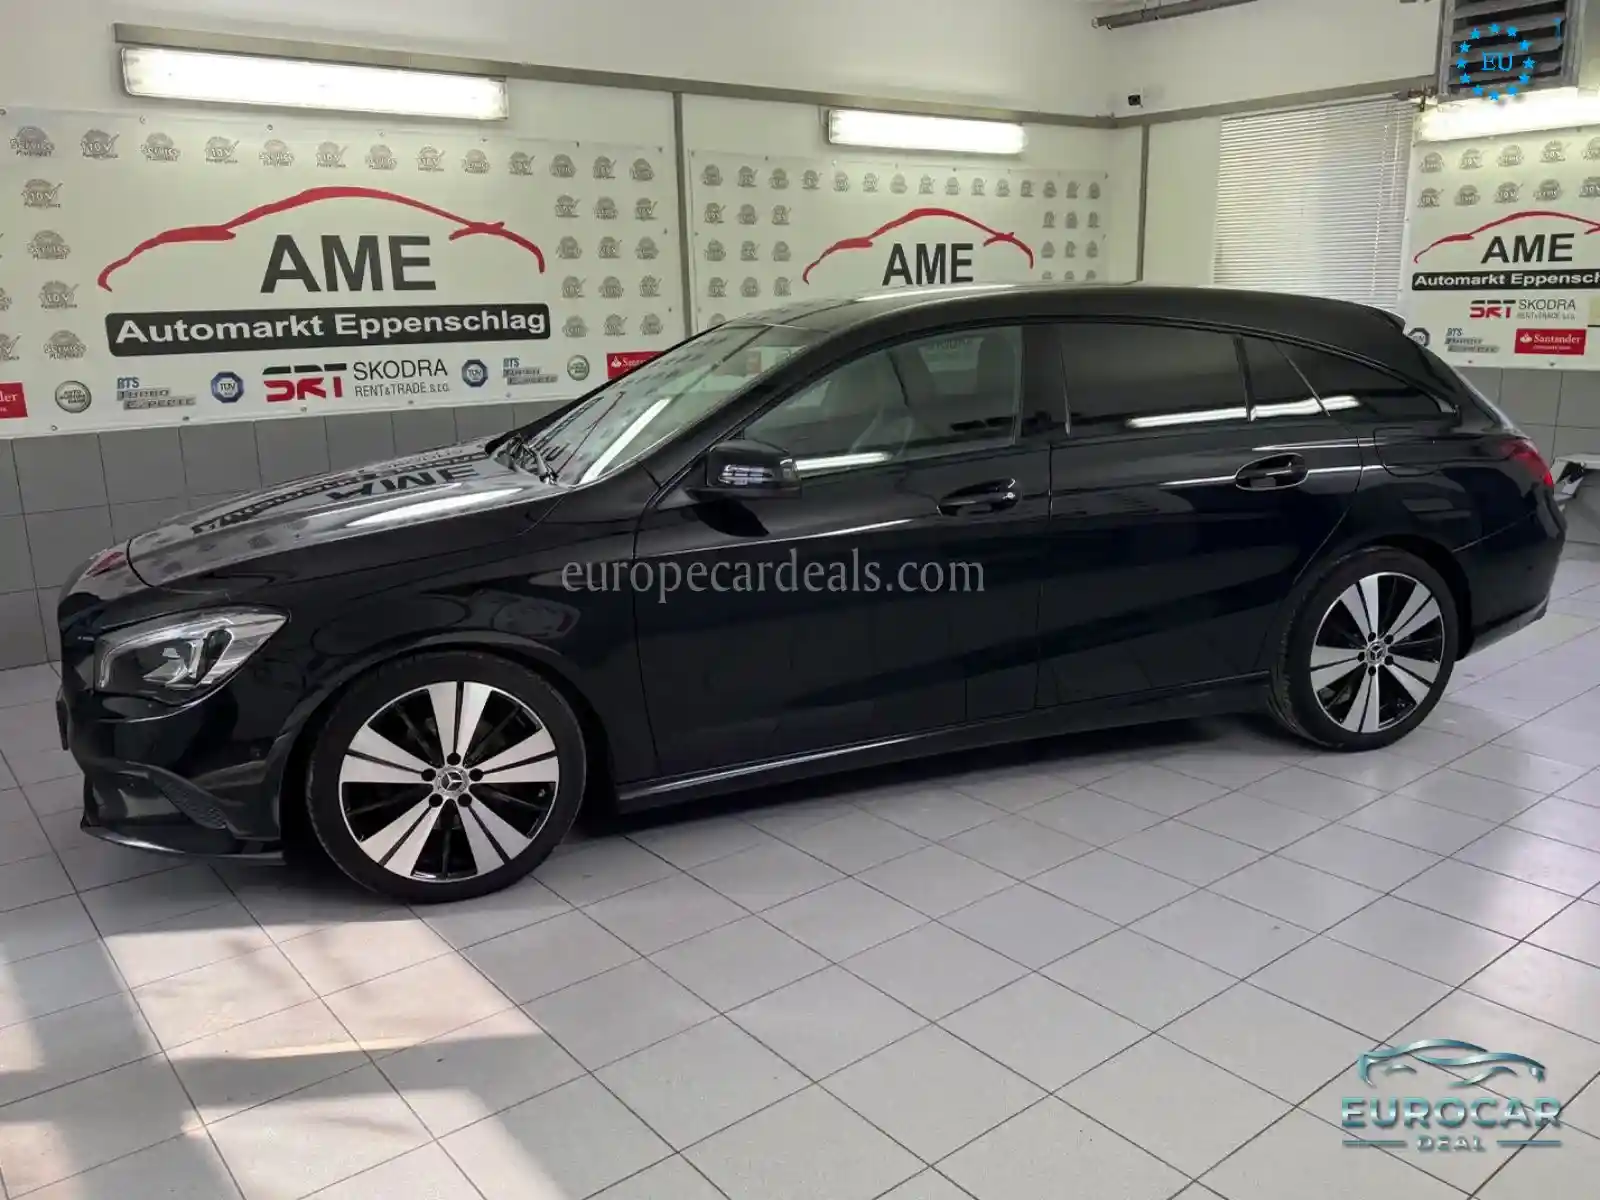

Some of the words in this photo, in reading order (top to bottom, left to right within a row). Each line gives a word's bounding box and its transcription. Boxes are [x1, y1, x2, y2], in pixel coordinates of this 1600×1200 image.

[1480, 233, 1575, 264] AME
[260, 234, 437, 294] AME
[883, 242, 974, 286] AME
[1414, 273, 1505, 287] Automarkt
[1518, 298, 1576, 311] SKODRA
[115, 314, 325, 345] Automarkt
[334, 310, 546, 339] Eppenschlag
[1533, 334, 1582, 344] Santander
[353, 358, 448, 381] SKODRA
